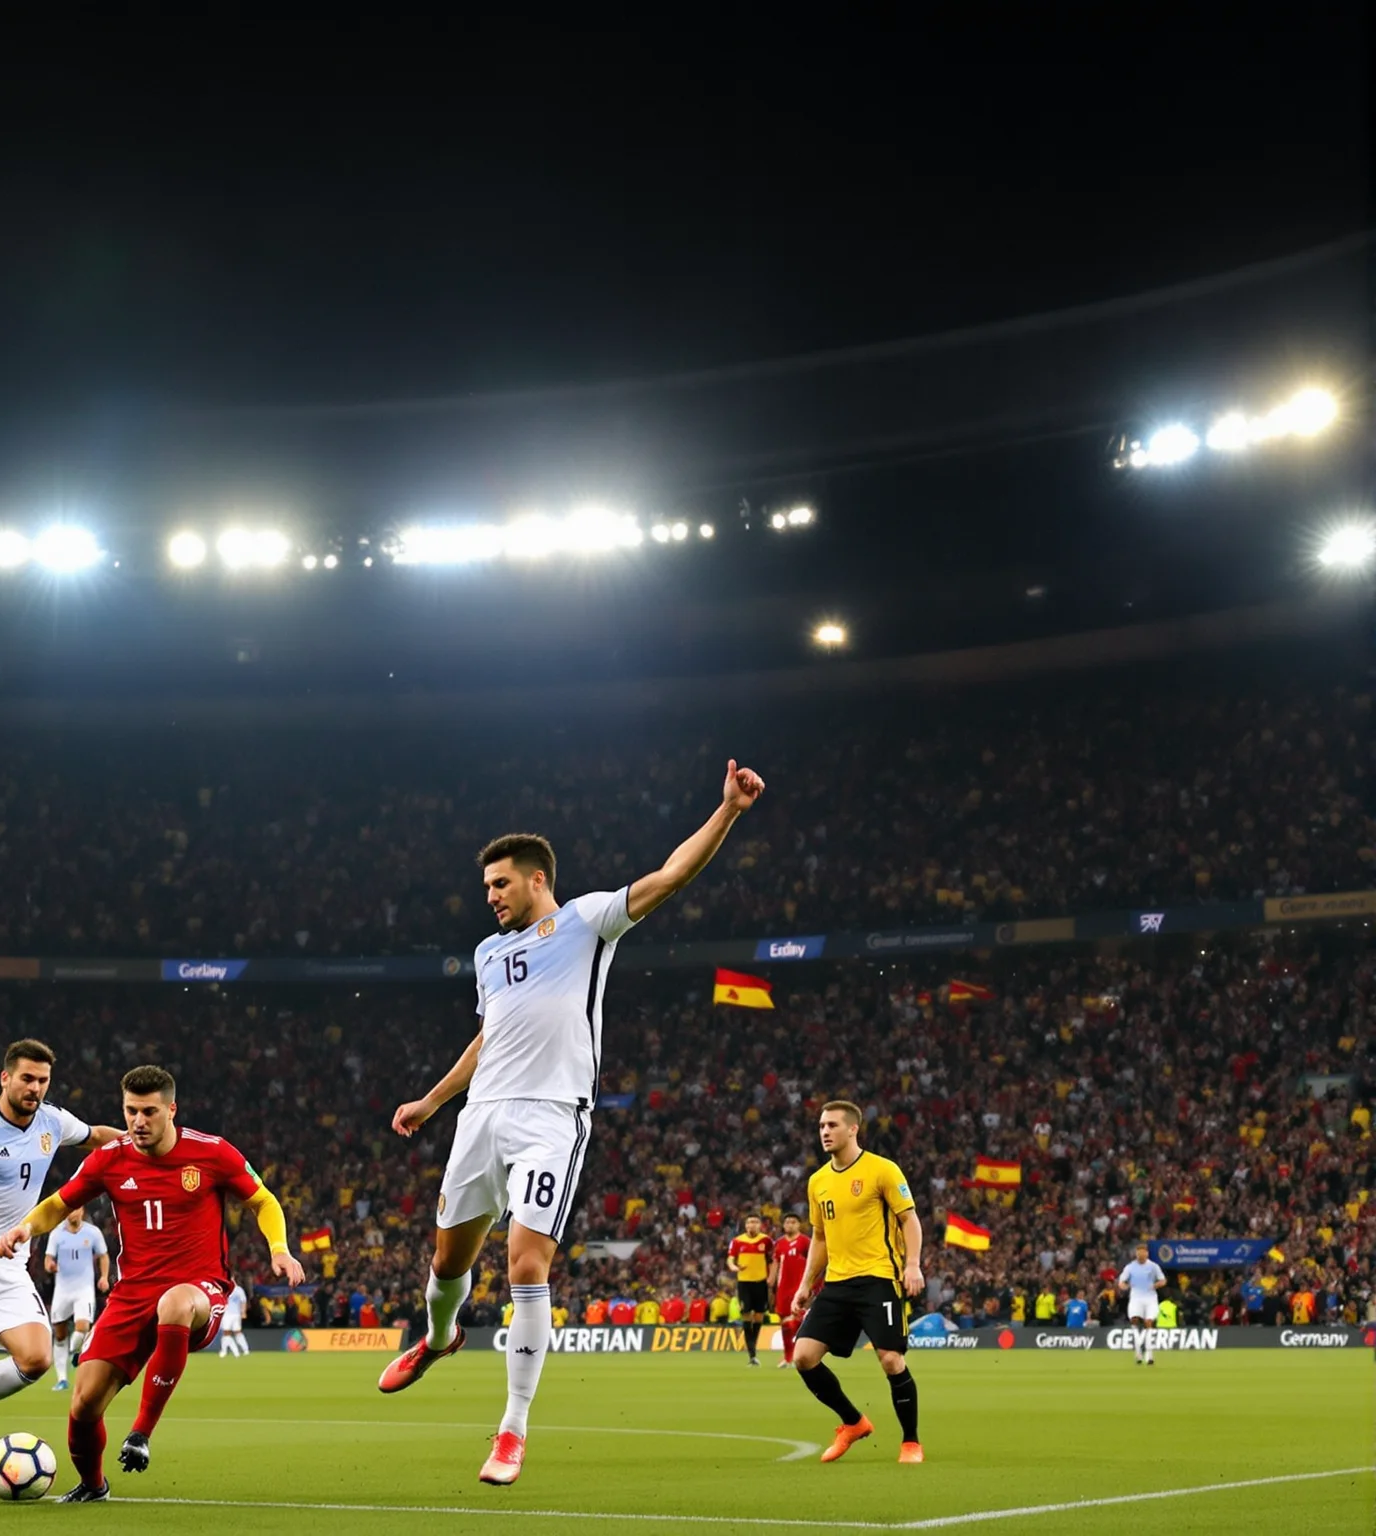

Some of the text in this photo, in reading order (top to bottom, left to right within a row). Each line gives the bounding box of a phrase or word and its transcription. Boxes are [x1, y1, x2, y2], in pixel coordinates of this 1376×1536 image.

[503, 949, 528, 987] 15
[20, 1162, 32, 1191] 9
[523, 1169, 556, 1208] 18
[143, 1200, 163, 1230] 11
[882, 1301, 894, 1327] 1
[1036, 1333, 1095, 1350] Germany
[1280, 1330, 1349, 1347] Germany
